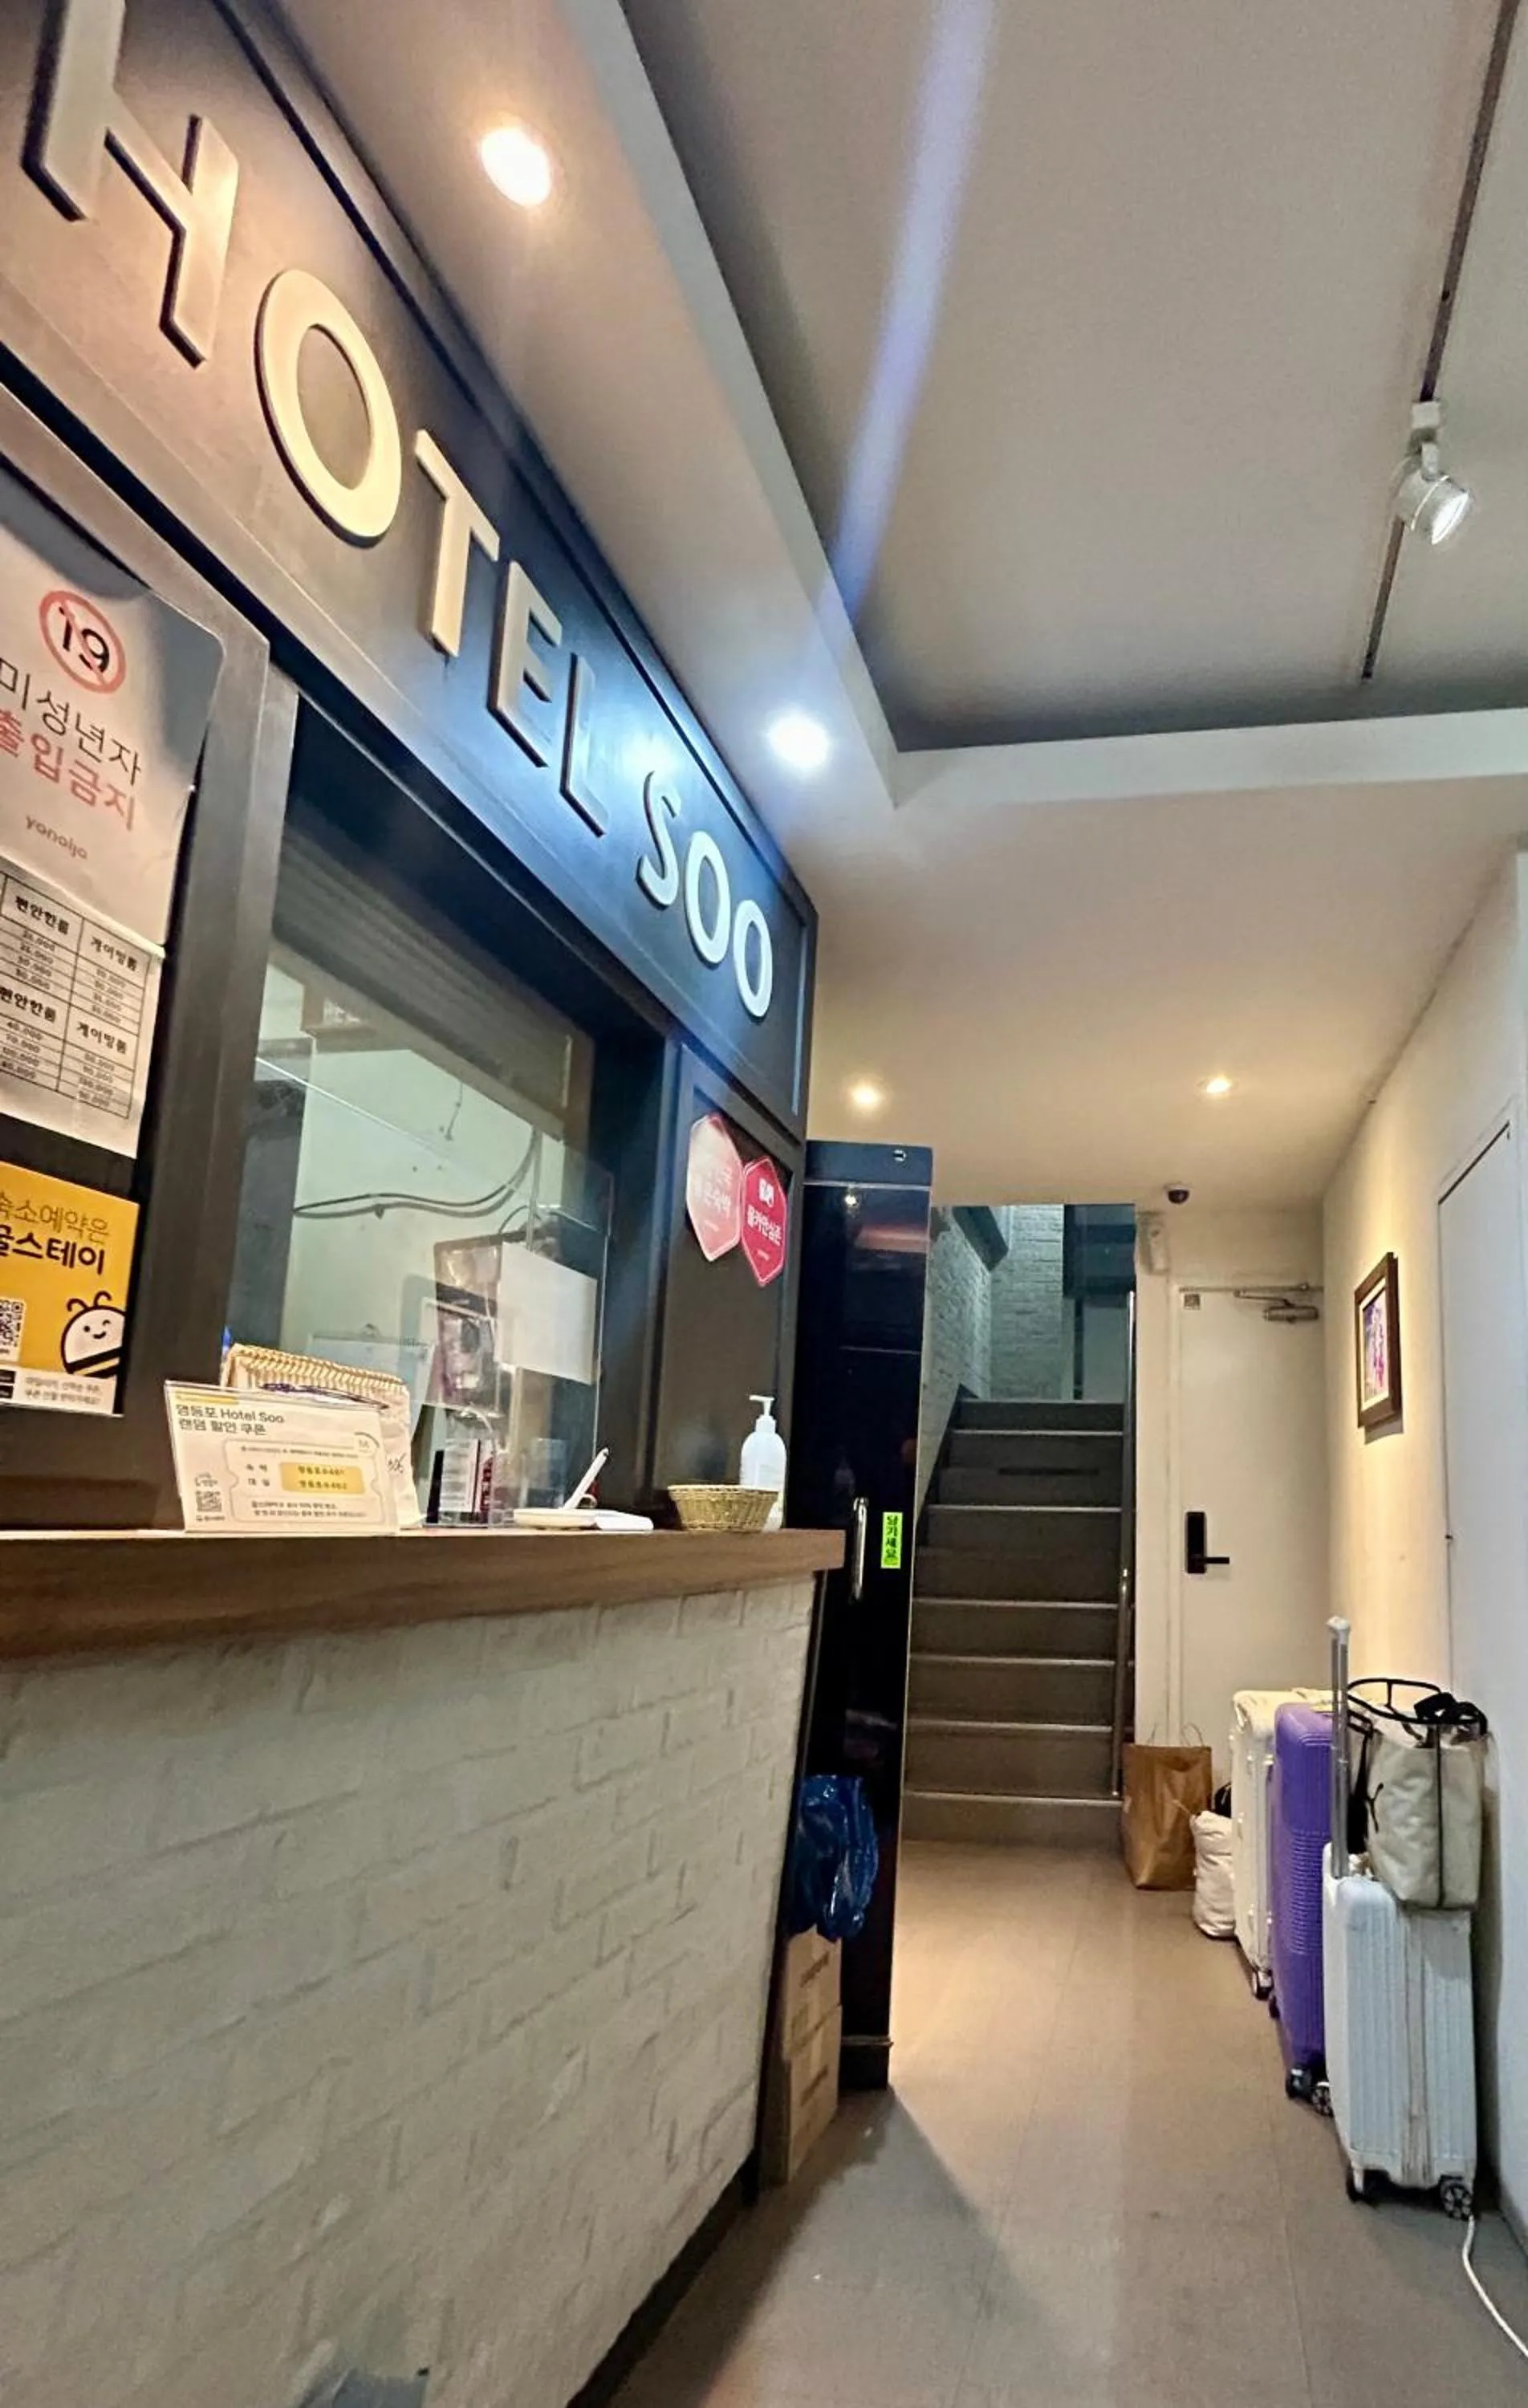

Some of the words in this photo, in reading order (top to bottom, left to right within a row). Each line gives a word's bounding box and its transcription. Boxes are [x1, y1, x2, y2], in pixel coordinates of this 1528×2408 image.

[22, 0, 608, 839] HOTEL
[636, 771, 773, 1019] SOO
[59, 605, 110, 673] 19
[0, 657, 141, 786] 미성년자
[0, 707, 136, 832] 출입금지
[220, 1408, 256, 1421] Hotel
[258, 1411, 285, 1423] Soo
[240, 1423, 267, 1436] 쿠폰
